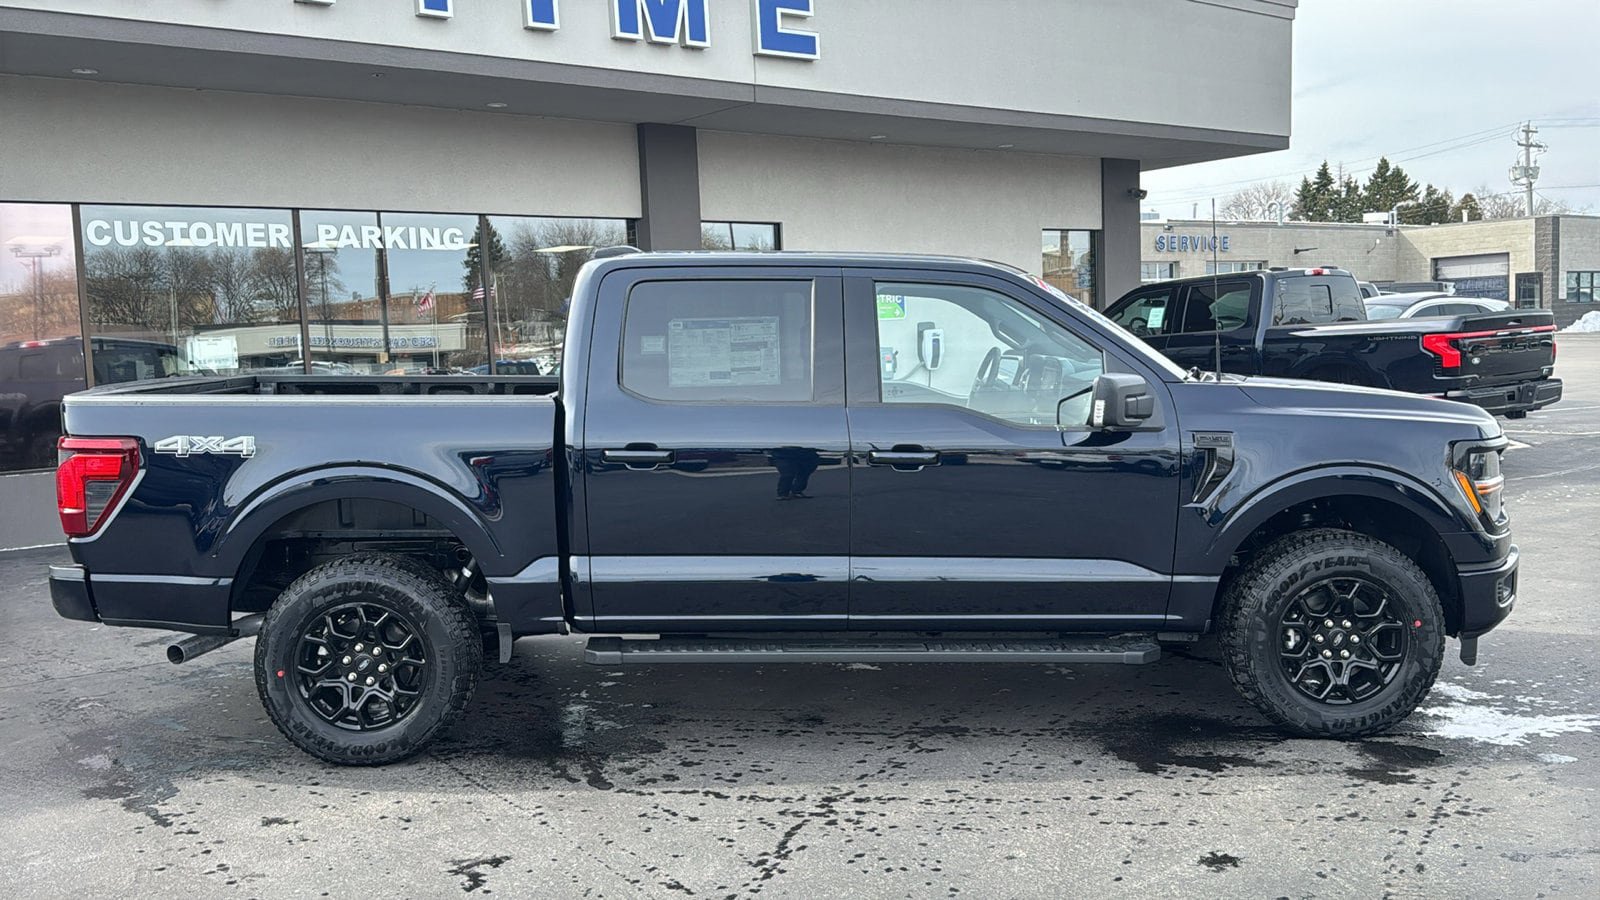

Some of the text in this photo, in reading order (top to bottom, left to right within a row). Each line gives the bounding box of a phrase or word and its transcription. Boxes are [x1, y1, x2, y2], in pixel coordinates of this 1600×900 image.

[86, 220, 464, 250] CUSTOMER PARKING
[1156, 235, 1230, 252] SERVICE
[1264, 556, 1358, 613] GOODYEAR
